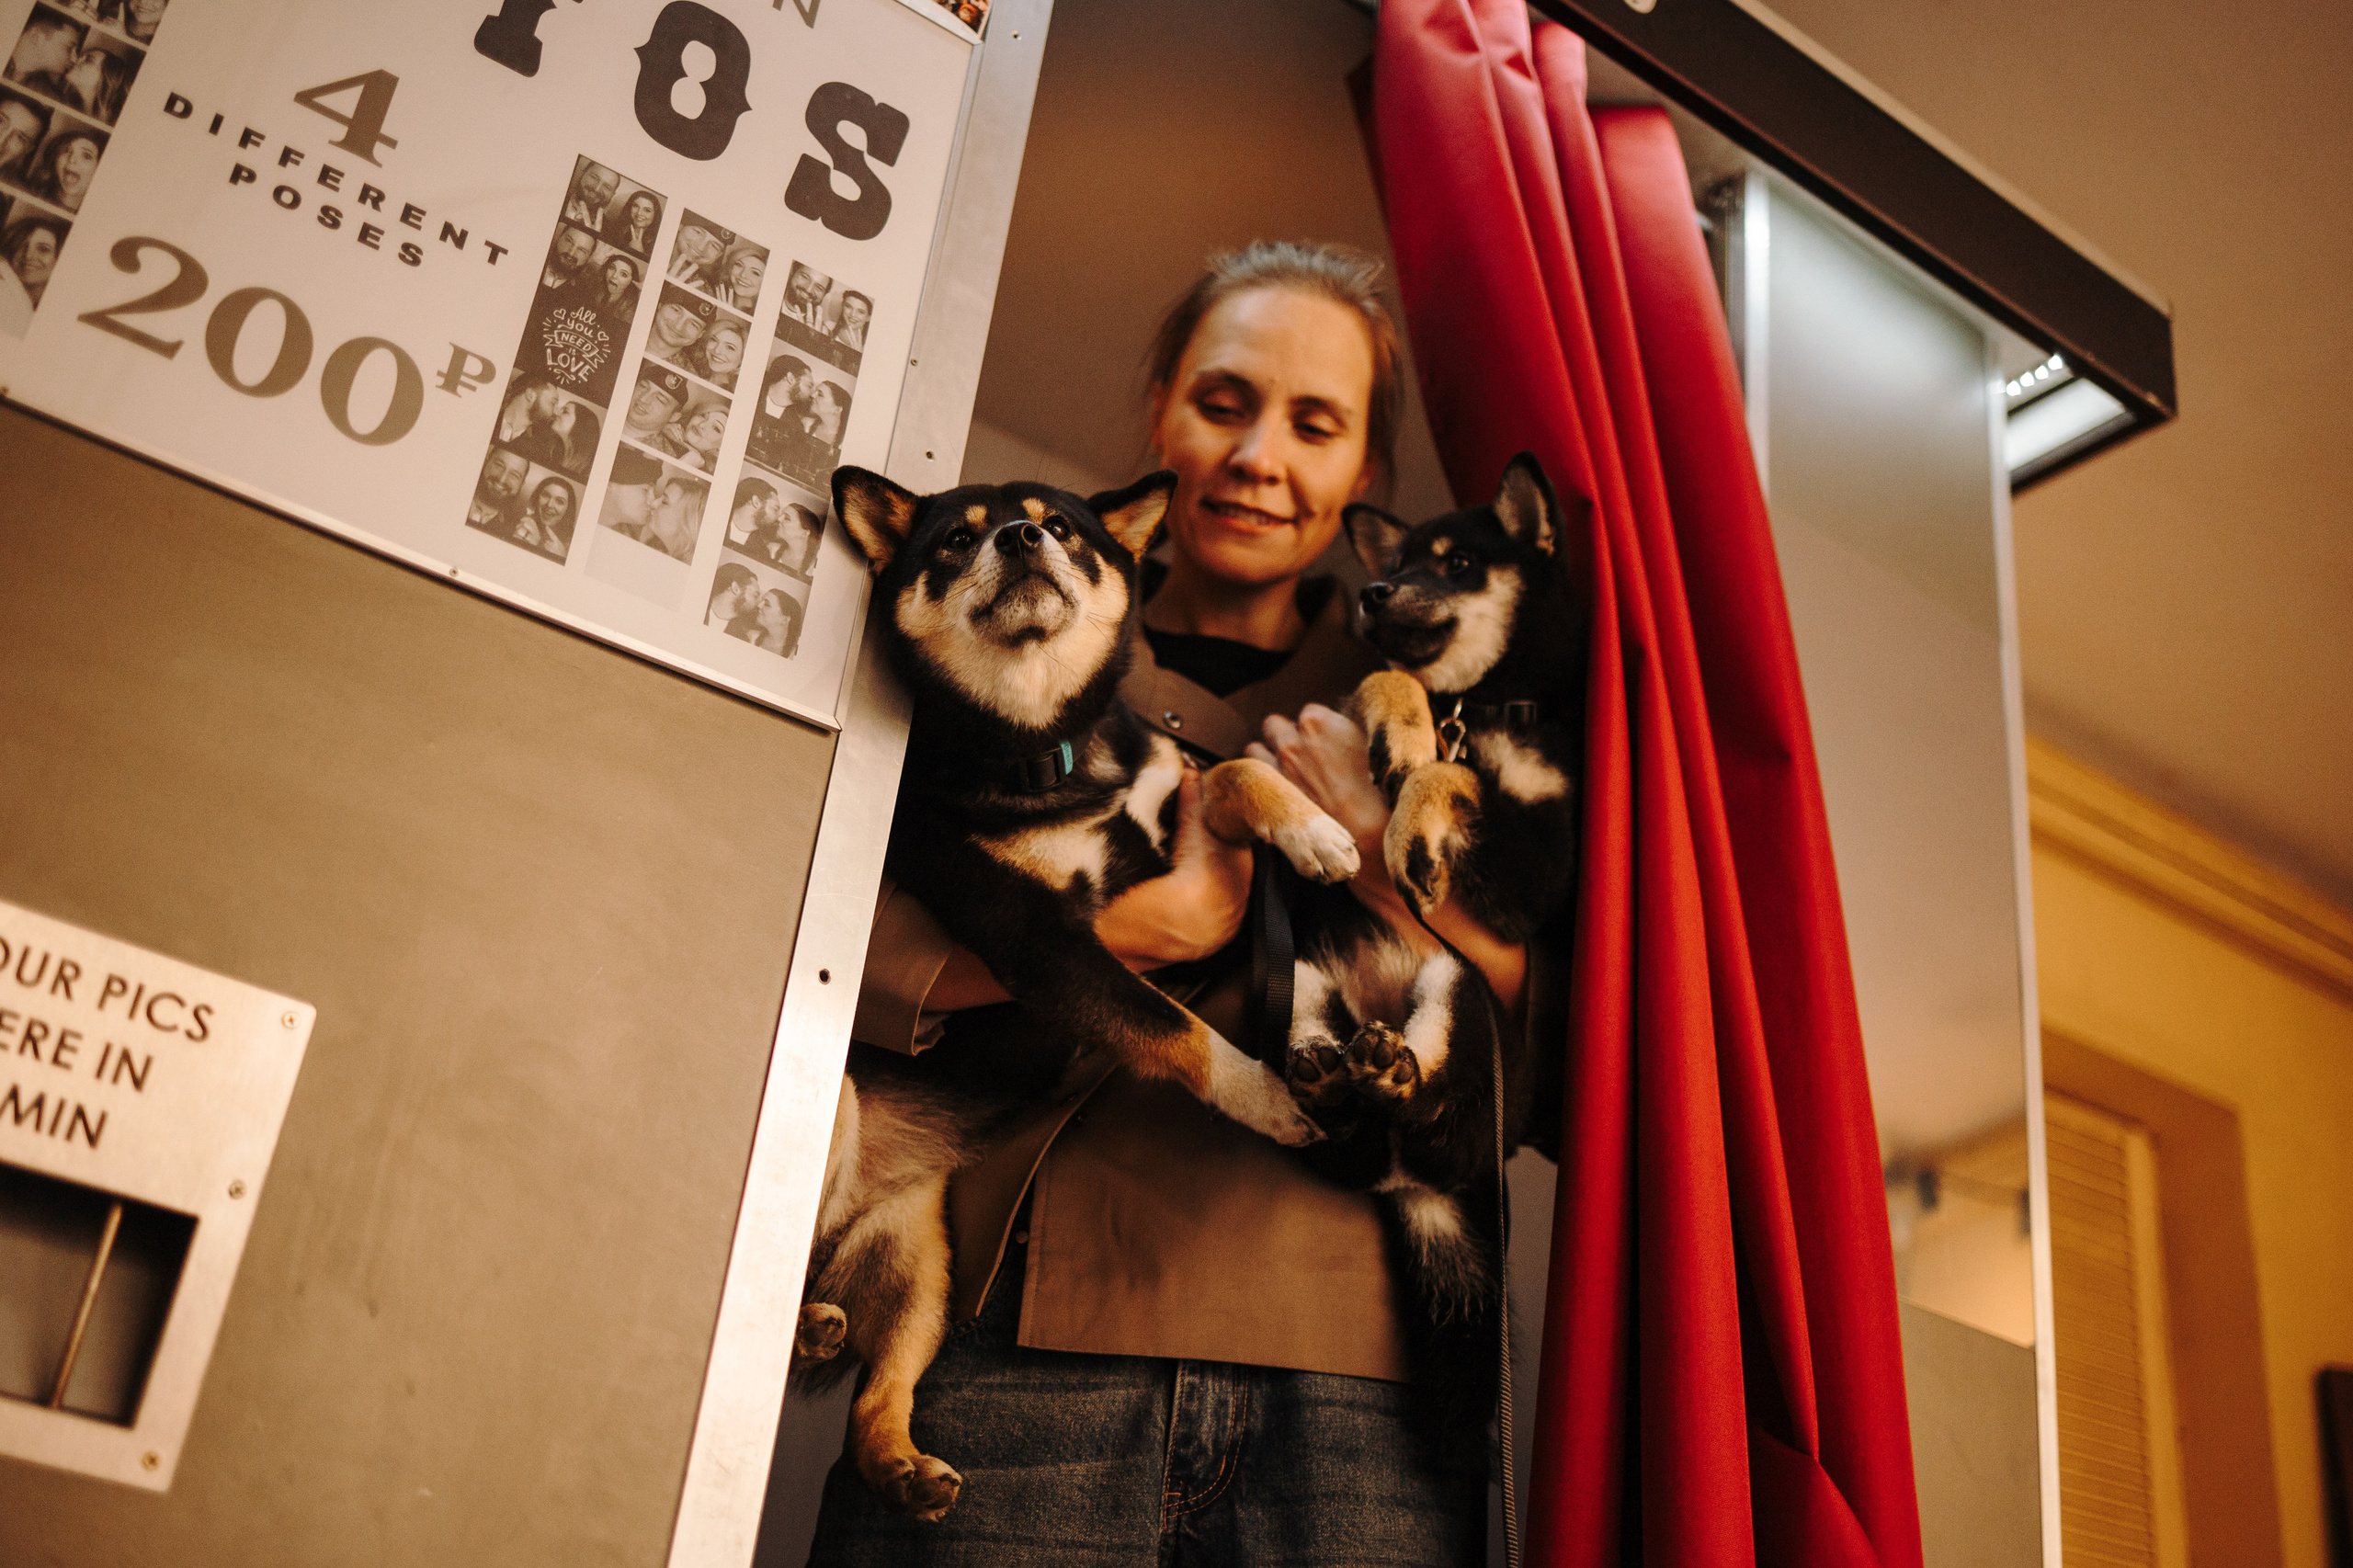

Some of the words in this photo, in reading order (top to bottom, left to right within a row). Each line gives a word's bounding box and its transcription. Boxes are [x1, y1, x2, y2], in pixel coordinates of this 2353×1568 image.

[293, 69, 400, 168] 4
[163, 91, 508, 266] DIFFERENT
[228, 162, 425, 267] POSES
[561, 333, 592, 354] NEED
[570, 306, 597, 324] All
[546, 347, 596, 382] LOVE
[97, 973, 214, 1042] PICS
[95, 1041, 153, 1093] IN
[0, 1083, 108, 1150] MIN
